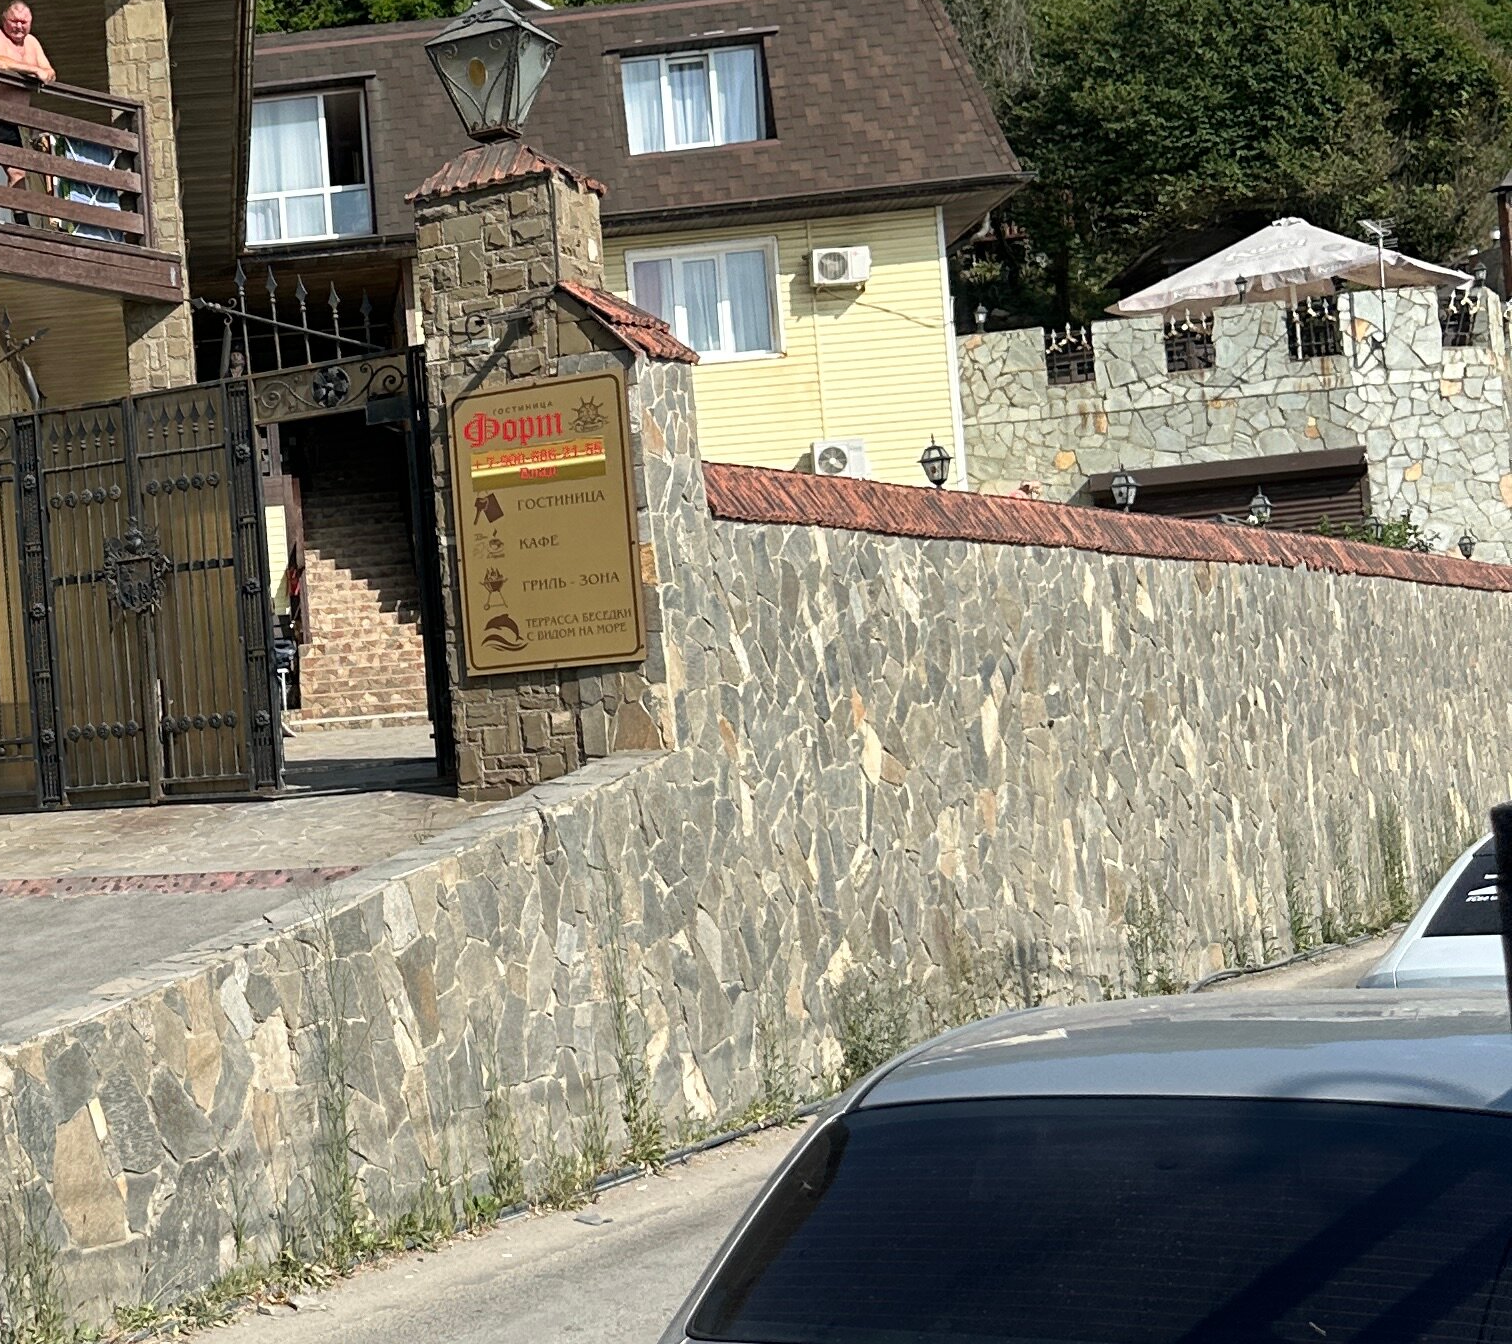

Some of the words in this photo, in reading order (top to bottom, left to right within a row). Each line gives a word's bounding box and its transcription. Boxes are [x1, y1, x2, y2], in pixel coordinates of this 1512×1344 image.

[492, 400, 553, 416] ГОСТИНИЦА
[463, 412, 563, 448] Форт
[517, 490, 605, 511] ГОСТИНИЦА
[519, 535, 559, 550] КАФЕ
[522, 577, 567, 592] ГРИЛЬ
[579, 571, 620, 586] ЗОНА
[526, 613, 579, 628] ТЕРРАССА
[582, 608, 632, 622] БЕСЕДКИ
[527, 631, 535, 642] С
[538, 627, 576, 641] ВИДОМ
[579, 626, 594, 637] НА
[597, 622, 627, 635] МОРЕ
